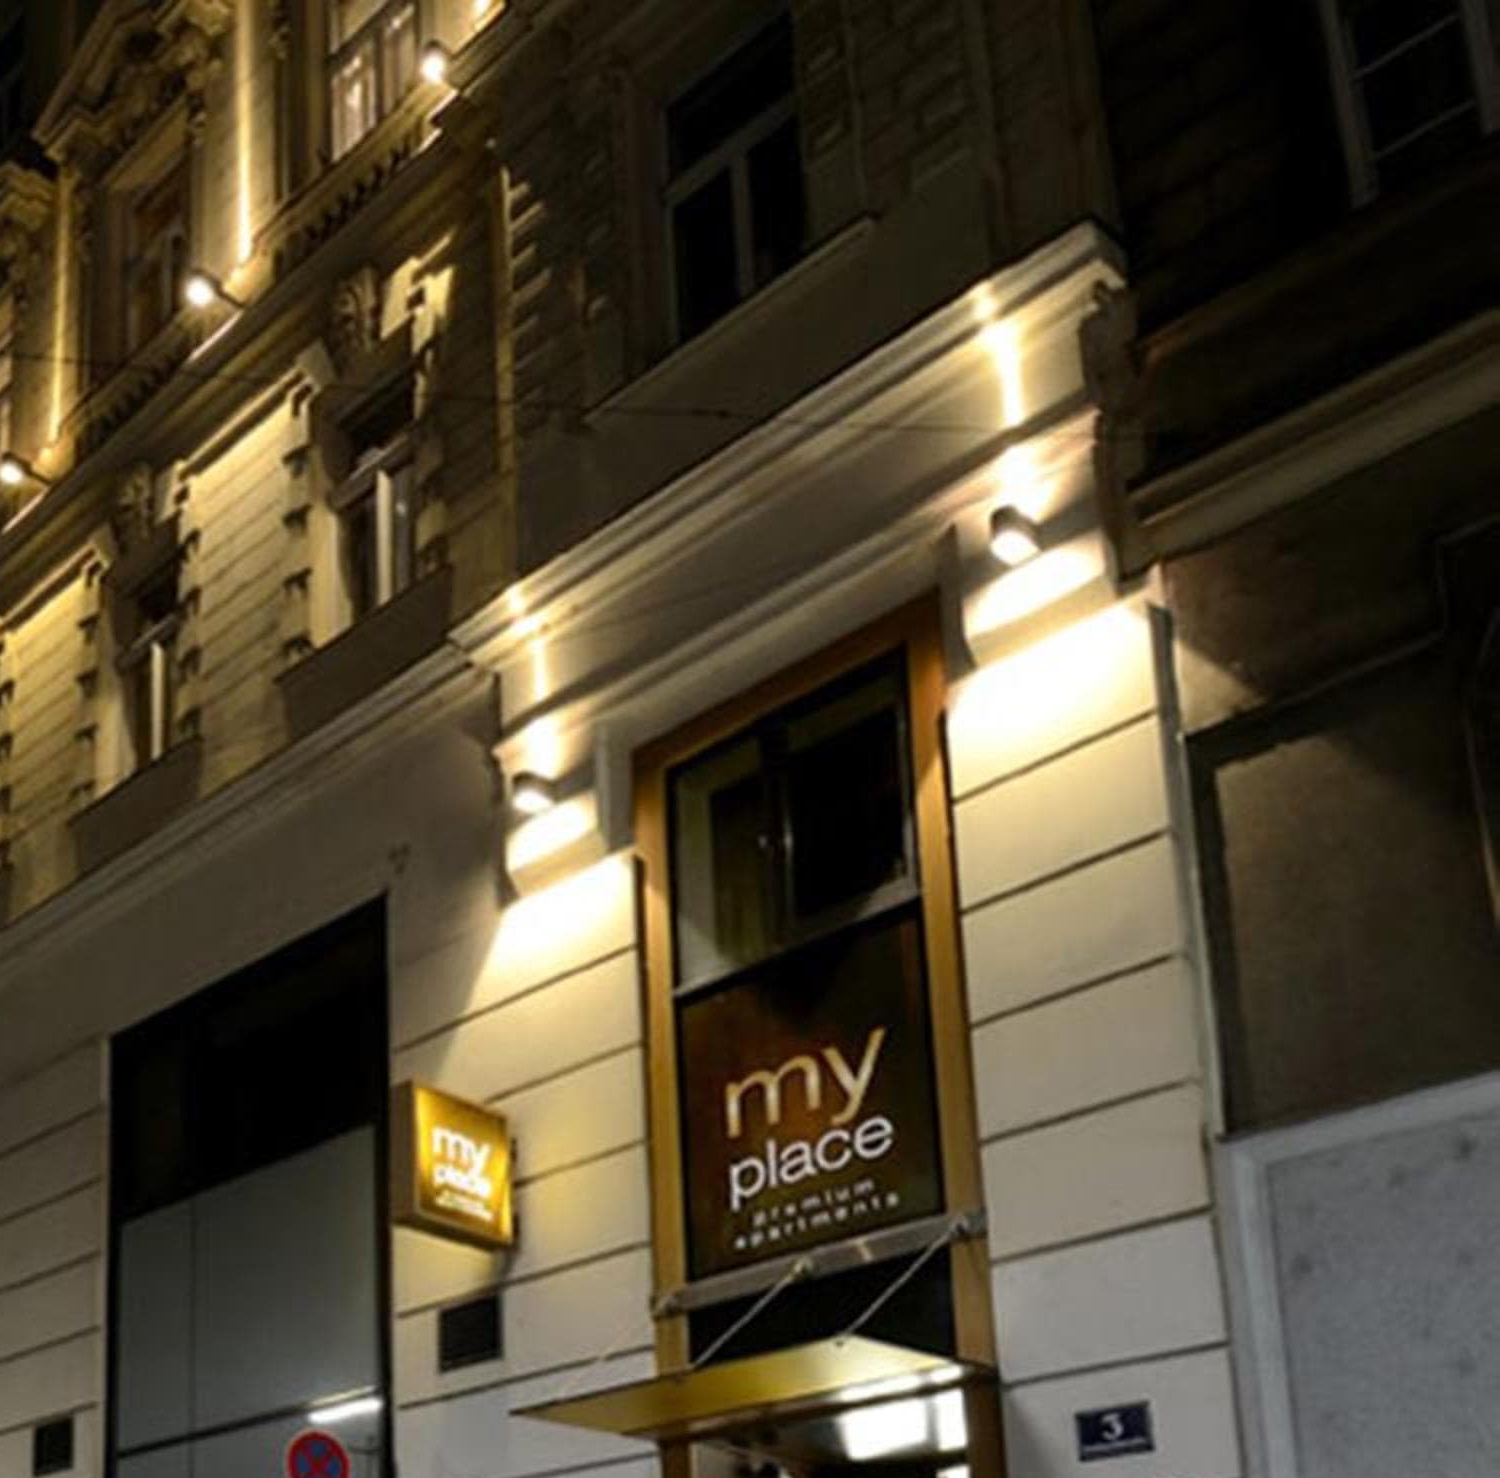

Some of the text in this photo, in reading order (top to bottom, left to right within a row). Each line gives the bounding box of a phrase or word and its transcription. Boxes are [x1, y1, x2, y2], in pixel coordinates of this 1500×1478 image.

[724, 1027, 886, 1139] my
[432, 1126, 491, 1177] my
[729, 1115, 894, 1212] place
[734, 1192, 900, 1248] apartments
[752, 1178, 874, 1228] premium
[1101, 1412, 1124, 1441] 3
